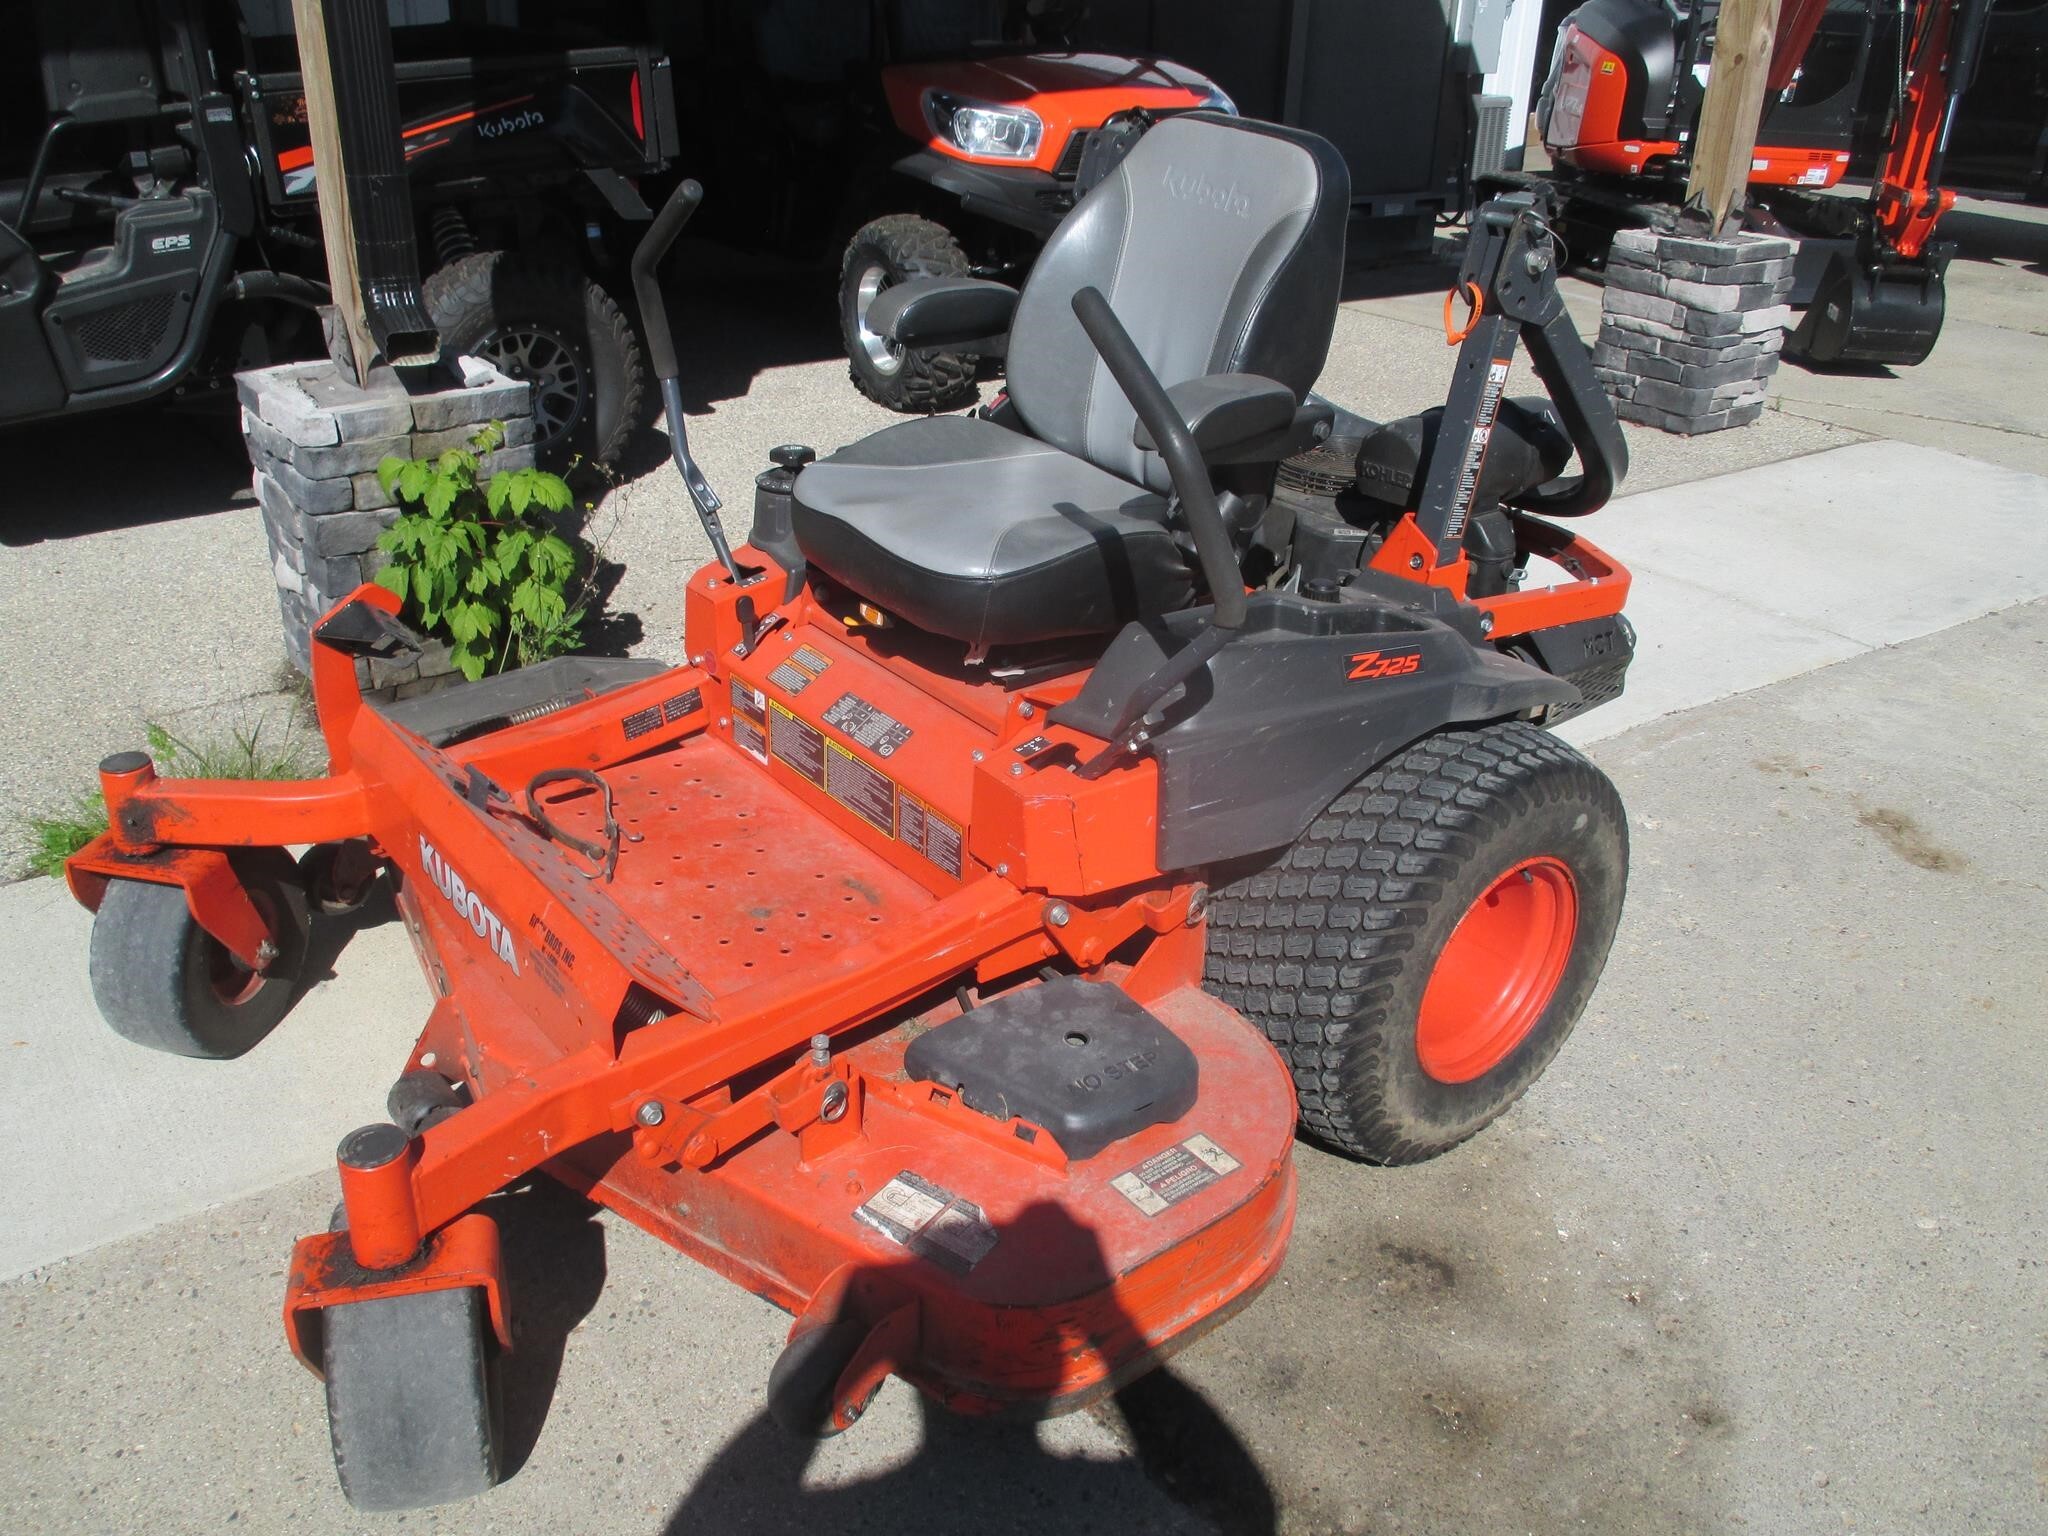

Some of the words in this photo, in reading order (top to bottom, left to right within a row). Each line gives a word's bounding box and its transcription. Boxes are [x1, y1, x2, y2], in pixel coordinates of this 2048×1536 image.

[477, 109, 545, 138] Kubota
[151, 233, 191, 250] EPS
[1348, 651, 1421, 679] Z725
[419, 832, 520, 977] KUBOTA
[1103, 1051, 1157, 1081] STEP
